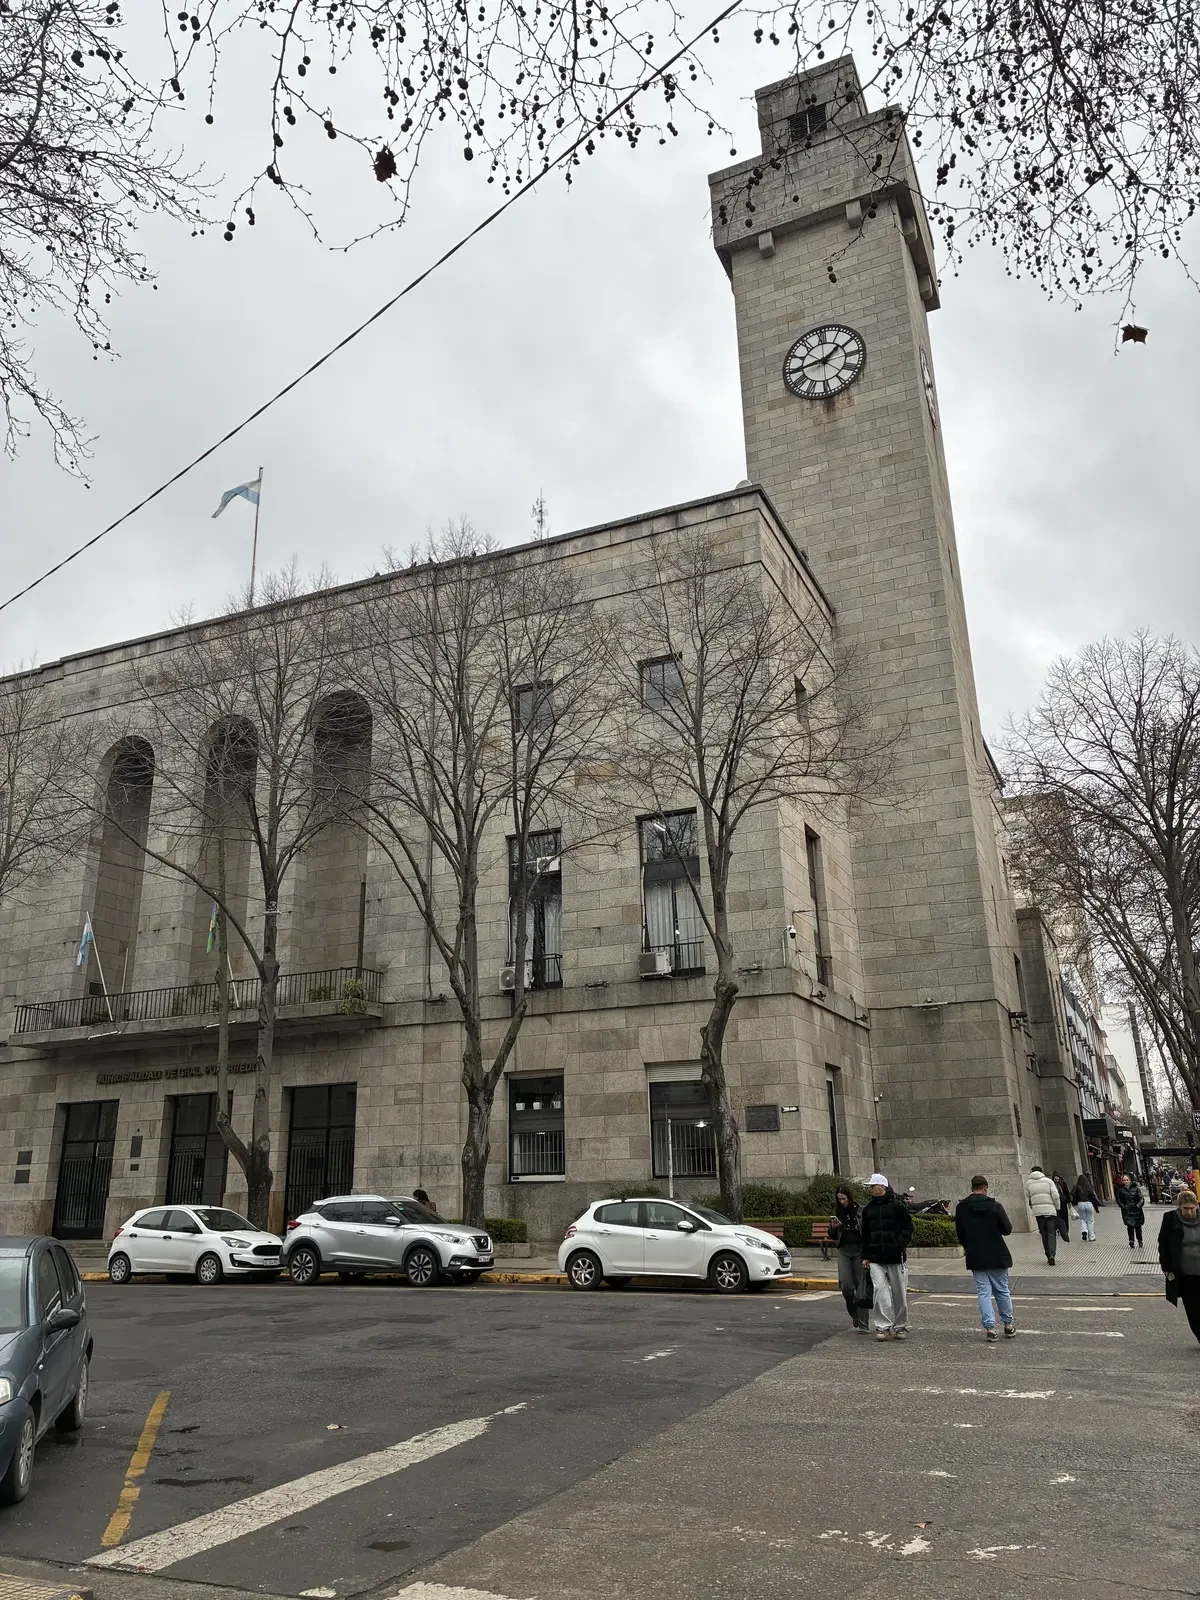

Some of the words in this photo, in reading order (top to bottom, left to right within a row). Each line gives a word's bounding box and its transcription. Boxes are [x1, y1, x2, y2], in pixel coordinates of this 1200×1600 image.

[817, 331, 827, 344] XII
[802, 339, 814, 351] XI
[97, 1071, 163, 1084] MUNICIPALIDAD
[165, 1069, 178, 1079] DE
